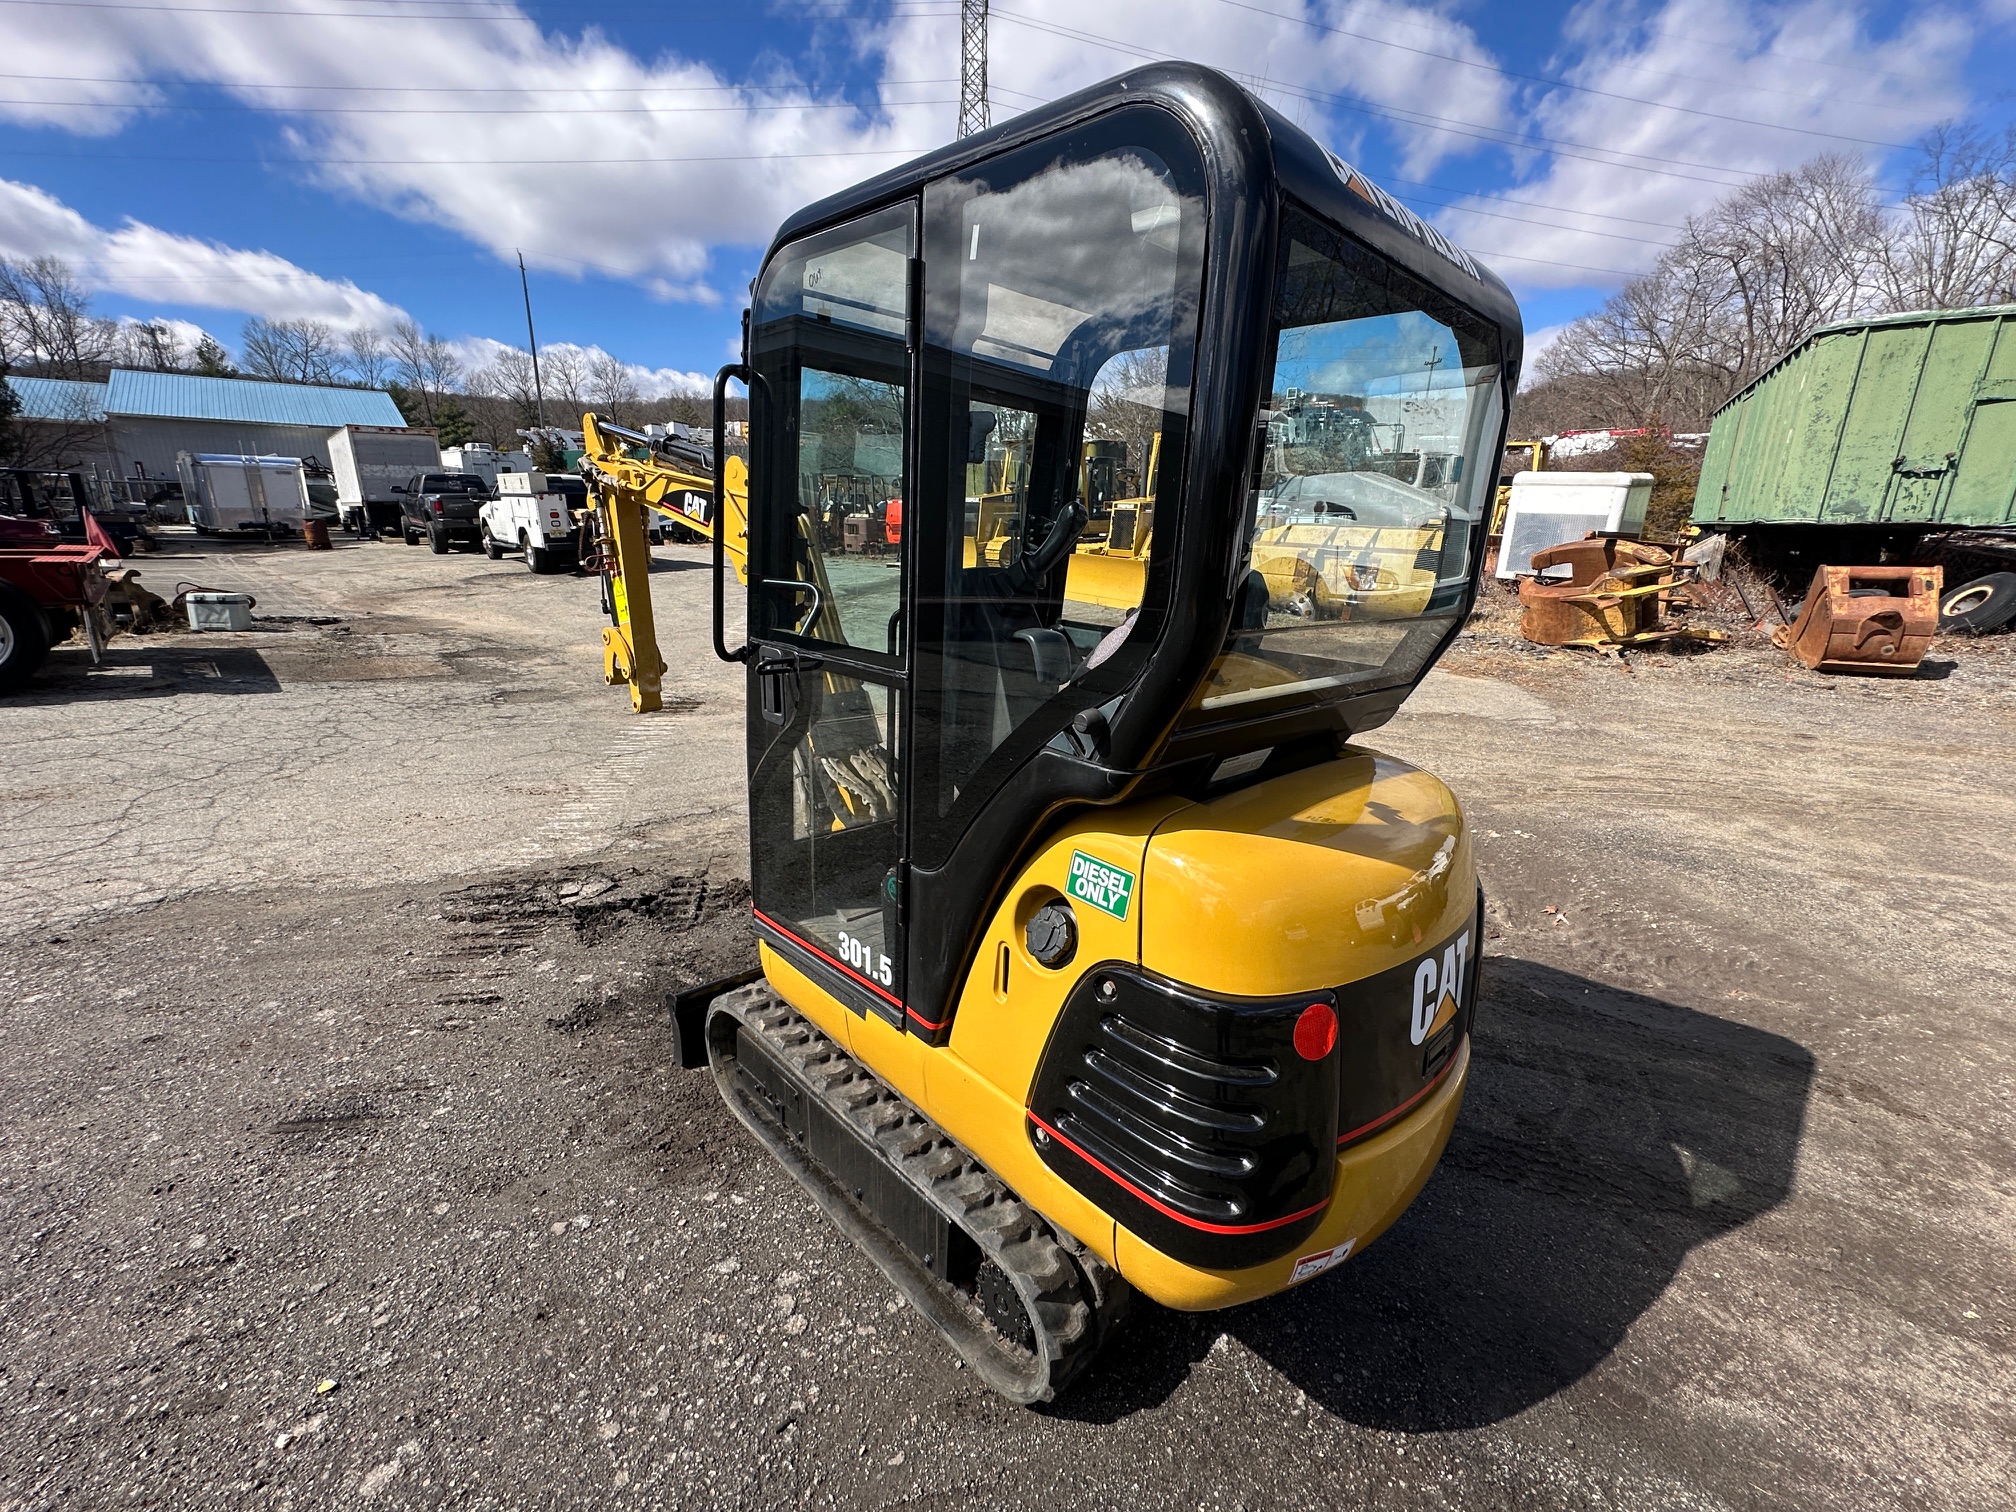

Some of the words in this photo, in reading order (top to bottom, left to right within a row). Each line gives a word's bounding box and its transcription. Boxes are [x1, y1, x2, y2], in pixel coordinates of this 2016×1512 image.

[683, 491, 708, 523] CAT
[1072, 856, 1129, 898] DIESEL
[1074, 876, 1121, 911] ONLY
[838, 931, 893, 987] 301.5
[1410, 929, 1470, 1047] CAT
